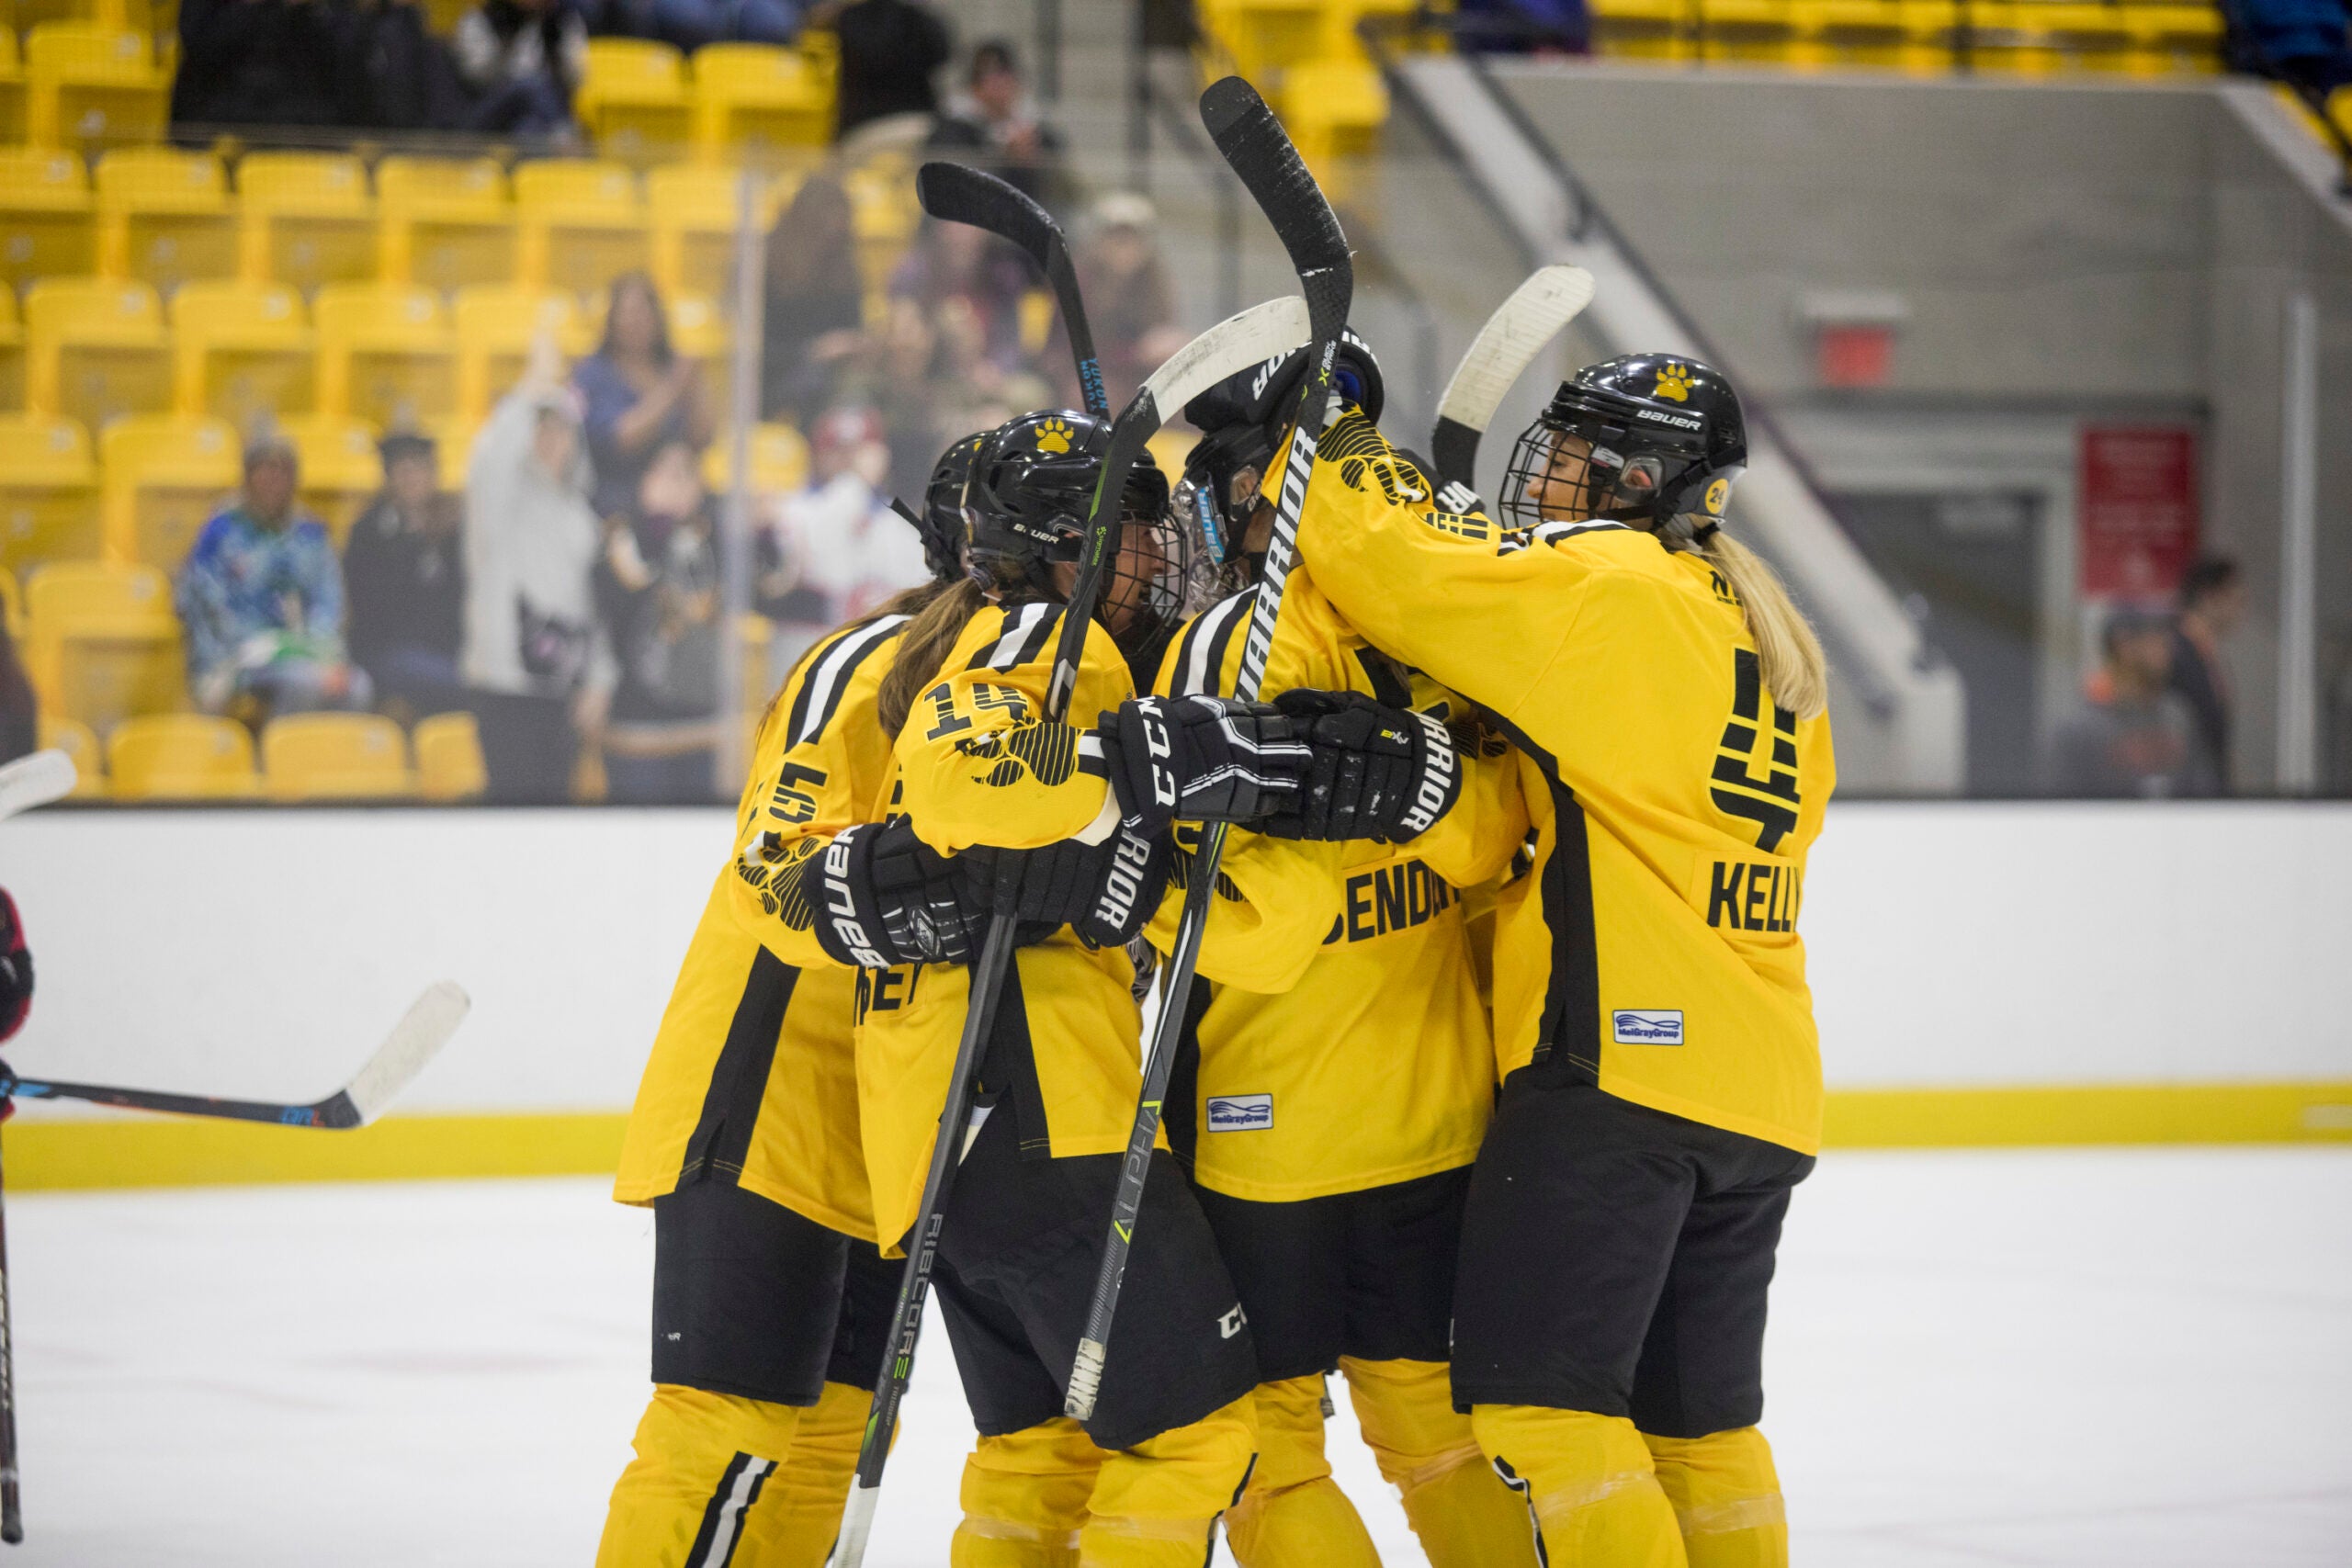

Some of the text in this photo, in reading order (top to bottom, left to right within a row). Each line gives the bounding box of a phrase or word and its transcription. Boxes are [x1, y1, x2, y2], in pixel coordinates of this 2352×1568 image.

[1636, 409, 1702, 431] BAUER
[1012, 522, 1060, 545] BUER
[1134, 694, 1177, 807] CCM
[1094, 829, 1151, 933] RIOR
[1706, 860, 1802, 933] KELL
[1114, 1100, 1162, 1245] ALPHA
